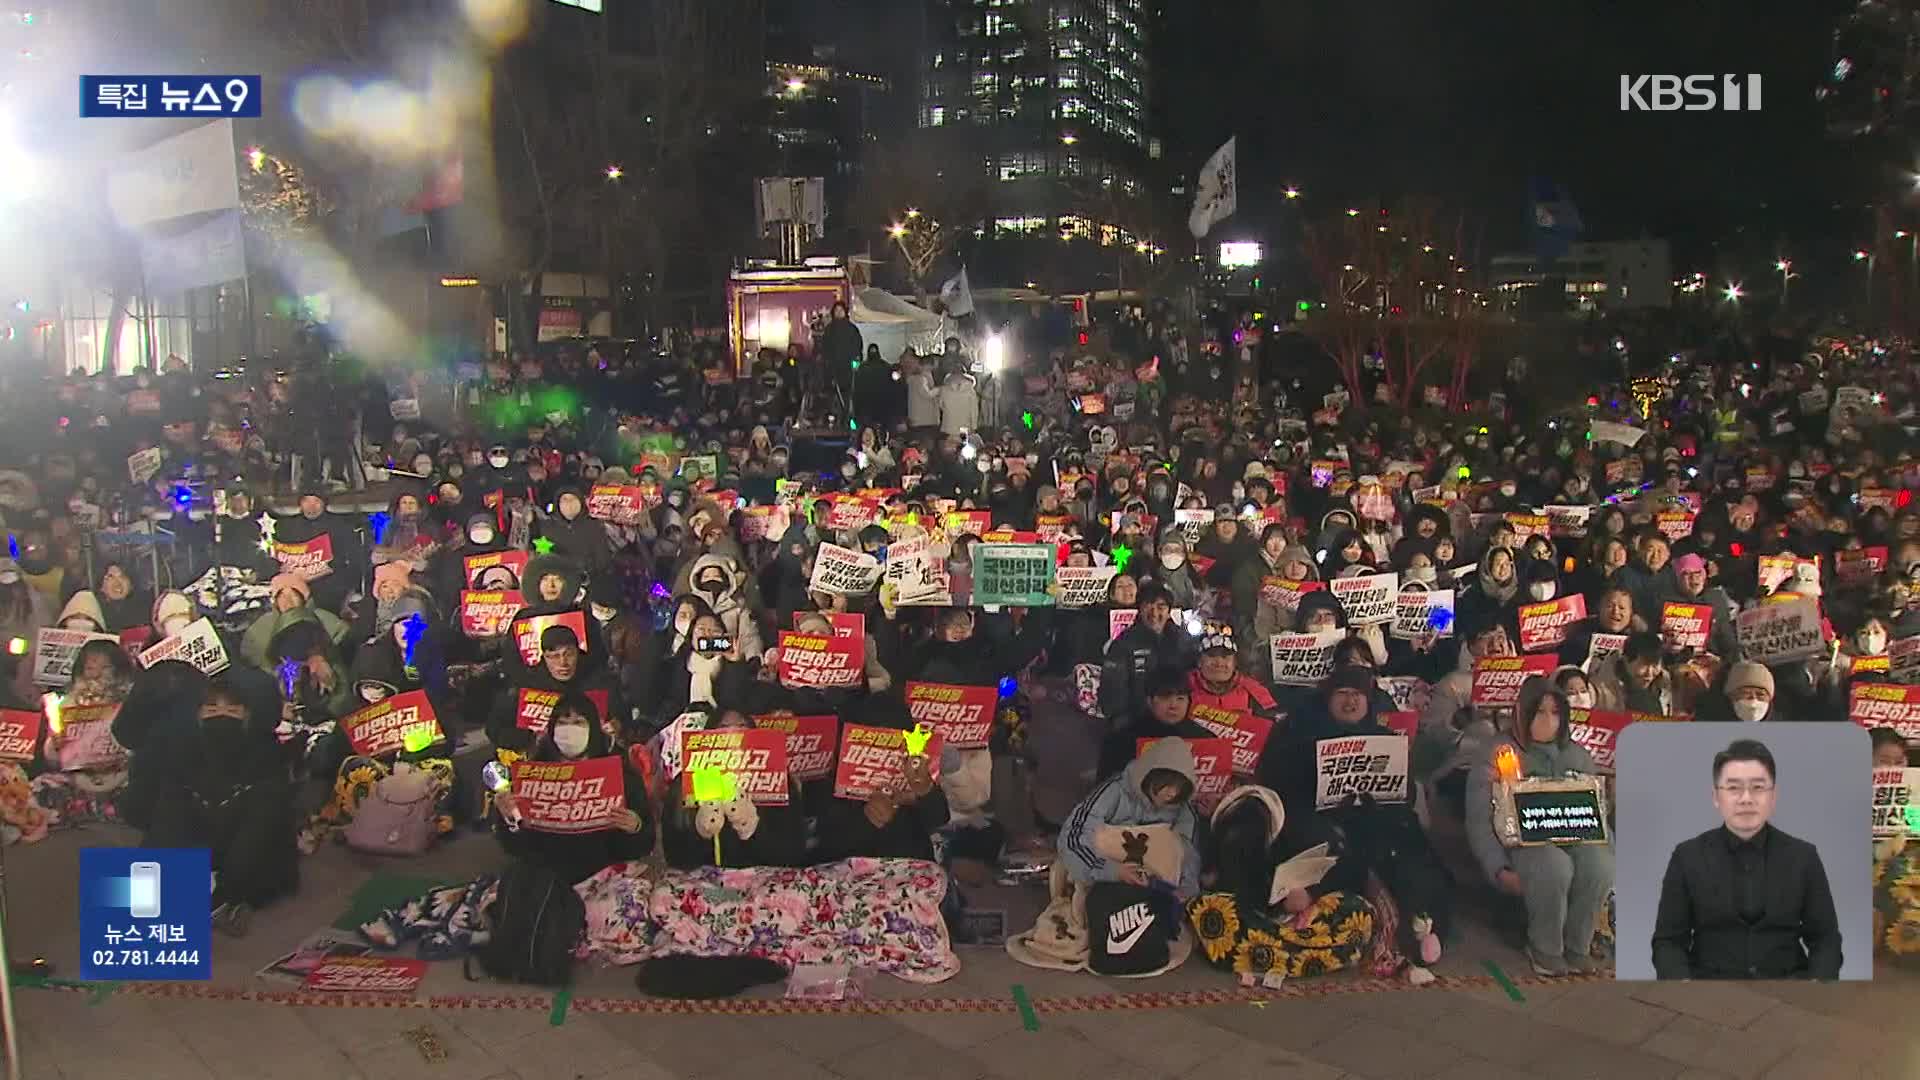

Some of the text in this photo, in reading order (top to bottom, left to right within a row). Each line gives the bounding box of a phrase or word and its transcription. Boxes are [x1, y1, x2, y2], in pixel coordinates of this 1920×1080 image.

[783, 648, 849, 668] 파면하고
[352, 705, 418, 742] 파면하고
[911, 701, 983, 723] 파면하고
[786, 735, 822, 752] 하고
[1569, 722, 1615, 746] 하고
[842, 744, 906, 769] 파면하
[1320, 740, 1367, 757] 내란정범
[685, 749, 770, 772] 파면하고
[787, 751, 834, 773] 하라!
[1321, 754, 1390, 777] 국힘당을
[520, 777, 606, 801] 파면하고
[737, 767, 785, 792] 하라!
[1326, 775, 1405, 797] 해산하라!
[1109, 903, 1149, 940] NIKE
